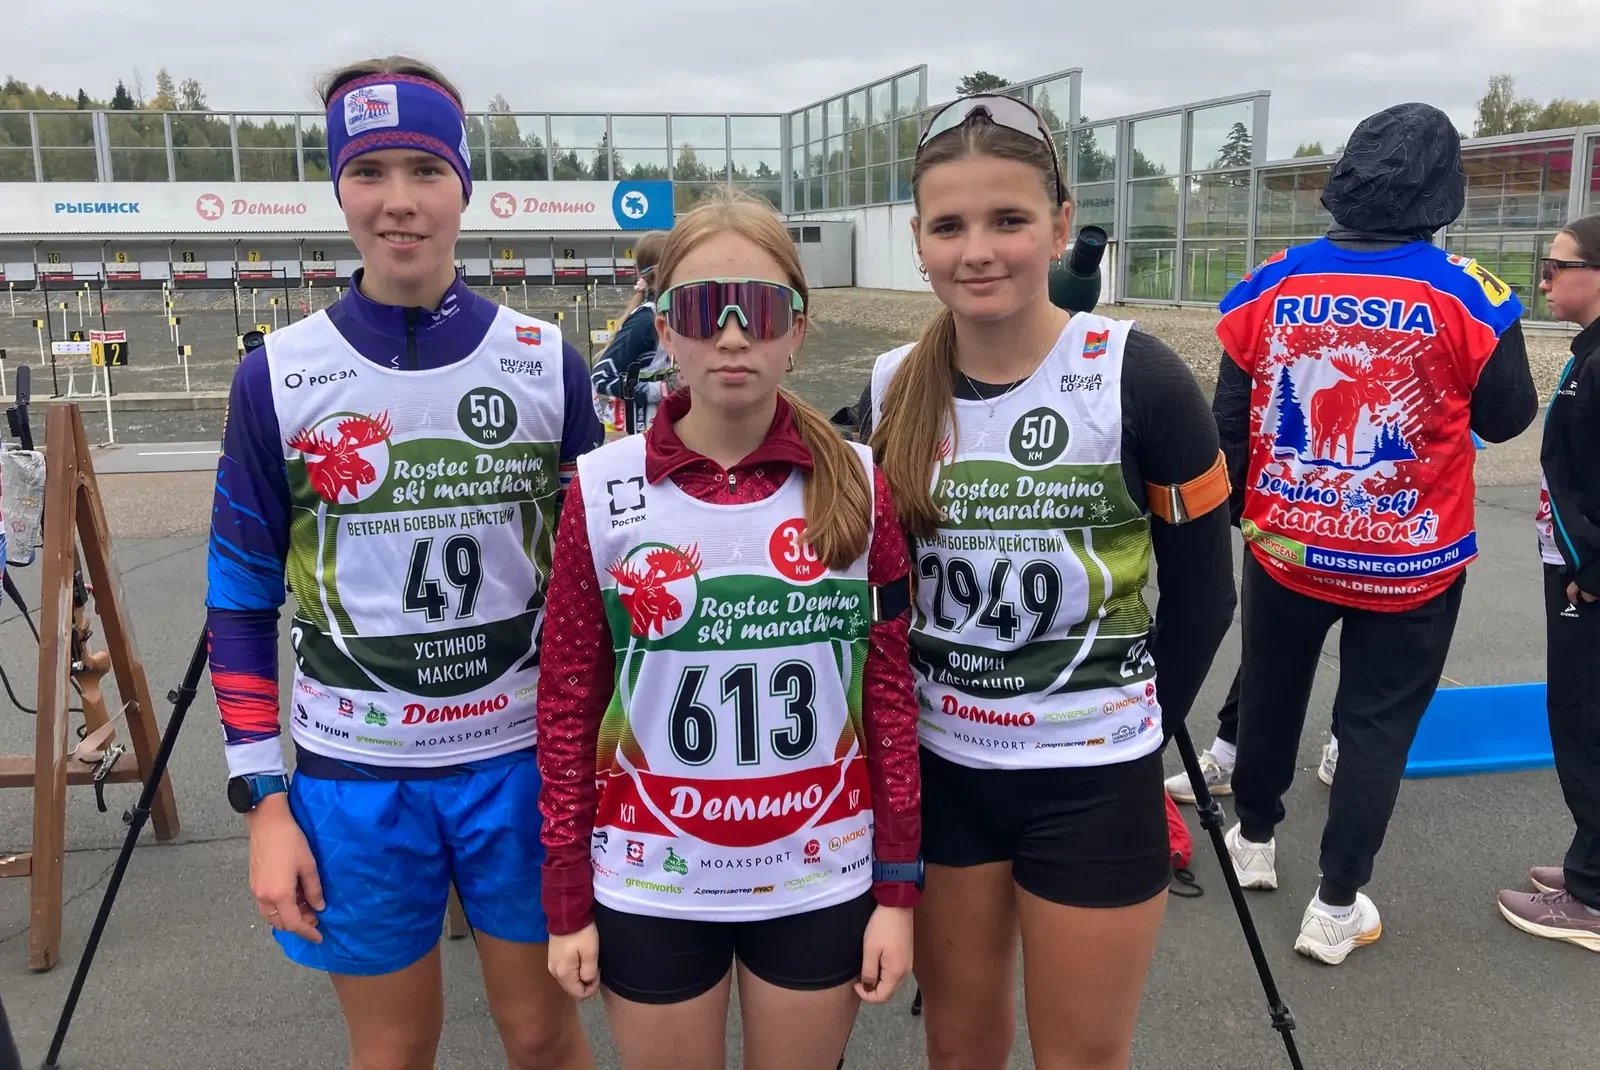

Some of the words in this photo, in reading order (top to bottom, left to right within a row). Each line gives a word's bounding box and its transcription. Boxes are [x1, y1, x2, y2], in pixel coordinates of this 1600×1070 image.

[55, 202, 141, 214] РЫБИНСК
[231, 199, 307, 215] Демино
[523, 197, 595, 213] Демино
[48, 254, 60, 263] 10
[119, 253, 125, 263] 9
[185, 252, 192, 262] 8
[251, 252, 257, 261] 7
[315, 251, 322, 261] 6
[505, 250, 511, 260] 3
[566, 250, 573, 259] 2
[1273, 294, 1437, 337] RUSSIA
[73, 331, 81, 342] 4
[94, 343, 100, 365] 3
[111, 343, 121, 365] 2
[500, 358, 543, 369] RUSSIA
[309, 368, 358, 386] РОСЭЛ
[1060, 373, 1102, 384] RUSSIA
[470, 394, 505, 428] 50
[1021, 414, 1057, 450] 50
[392, 459, 469, 481] Rostec
[474, 453, 543, 475] Demino
[392, 479, 426, 505] ski
[433, 474, 532, 500] marathon
[939, 478, 1009, 500] Rostec
[1016, 475, 1104, 498] Demino
[1255, 469, 1338, 505] Demino
[1375, 489, 1419, 516] ski
[611, 513, 647, 529] Ростех
[940, 499, 968, 525] ski
[975, 498, 1084, 522] marathon
[347, 518, 400, 536] ВЕТЕРАН
[403, 513, 457, 532] БОЕВЫХ
[948, 535, 996, 550] БОЕВЫХ
[999, 534, 1064, 554] ДЕЙСТВИЙ
[1311, 547, 1460, 574] RUSSNEGOHOD.RU
[402, 533, 484, 623] 49
[700, 596, 779, 619] Rostec
[786, 589, 860, 614] Demino
[918, 552, 1063, 643] 2949
[697, 620, 733, 645] ski
[741, 613, 844, 639] marathon
[413, 633, 487, 661] УСТИНОВ
[417, 656, 488, 685] МАКСИМ
[948, 650, 1005, 673] ФОМИН
[401, 693, 509, 725] Демино
[668, 659, 818, 767] 613
[941, 694, 1036, 727] Демино
[315, 721, 350, 739] BIVIUM
[415, 725, 500, 747] MOAXSPORT
[953, 731, 1026, 750] MOAXSPORT
[356, 735, 405, 748] greenworks
[669, 783, 823, 822] Демино
[620, 803, 636, 825] КЛ
[700, 851, 792, 869] MOAXSPORT
[803, 856, 821, 865] RM
[841, 853, 870, 874] BIVIUM
[625, 877, 685, 895] greenworks
[753, 884, 775, 895] PRO
